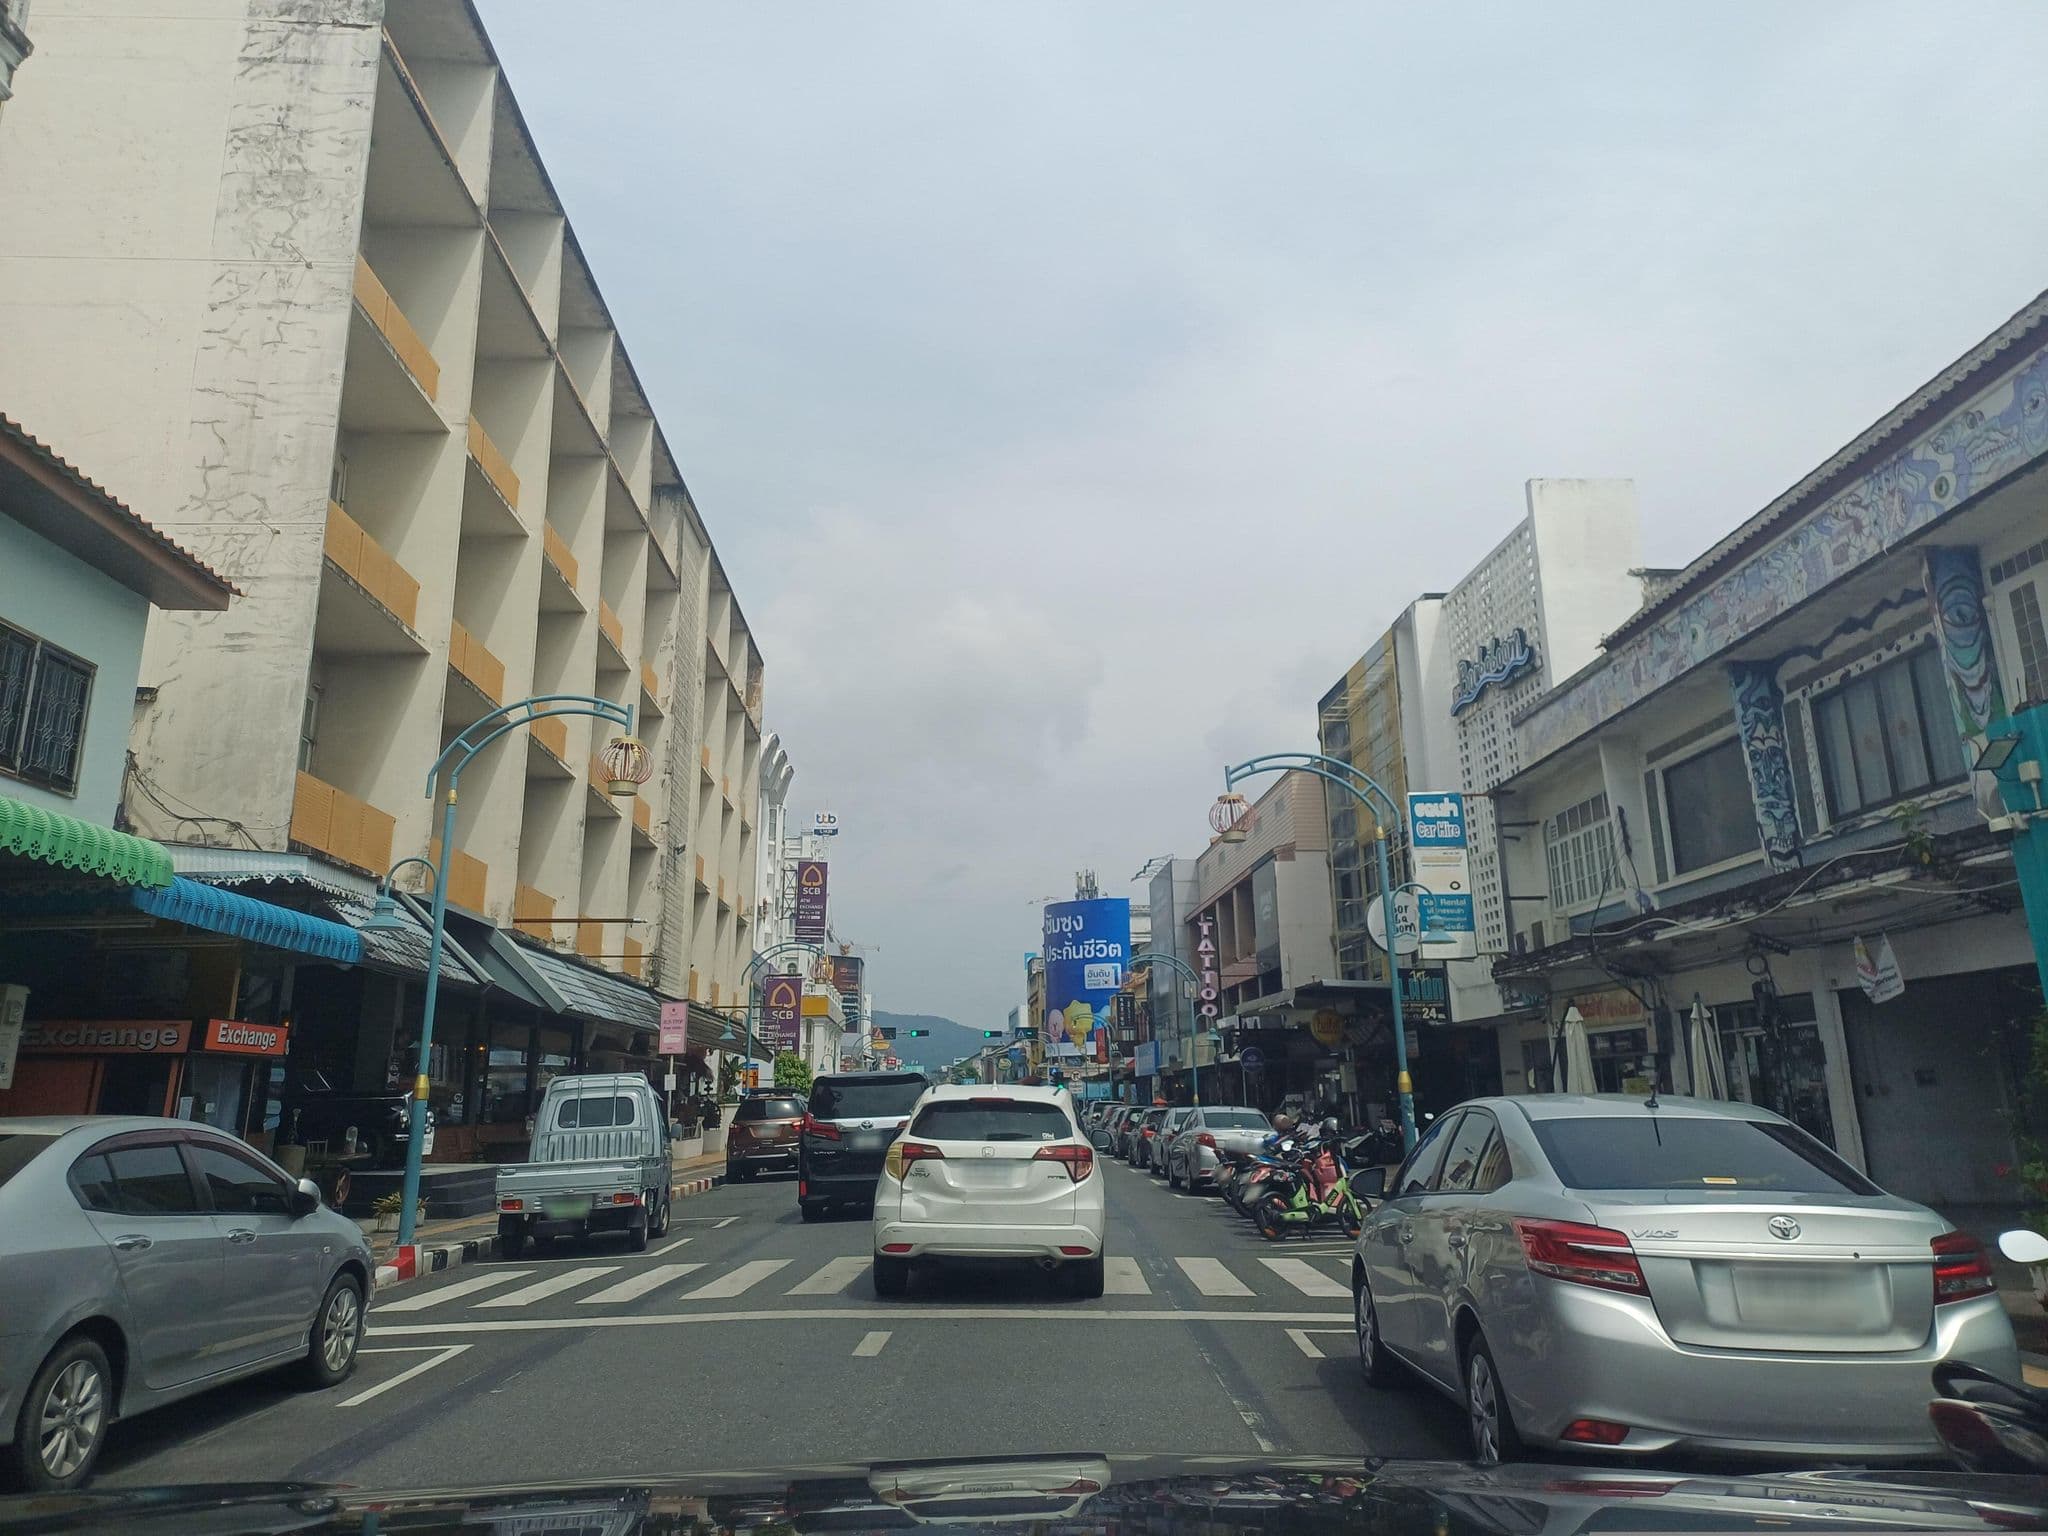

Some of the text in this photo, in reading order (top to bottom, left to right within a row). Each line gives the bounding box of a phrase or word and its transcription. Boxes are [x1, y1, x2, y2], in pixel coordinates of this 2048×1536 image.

[815, 813, 837, 824] ttb
[1416, 820, 1461, 839] Car Hire
[802, 887, 821, 895] SCB
[1440, 898, 1467, 906] Rental
[1045, 914, 1084, 938] ซัมซุง
[1046, 938, 1122, 962] ประกันชีวิต
[1197, 921, 1218, 1017] TATTOO
[772, 1010, 794, 1020] SCB
[1422, 1007, 1437, 1019] 24
[23, 1023, 180, 1050] Exchange
[217, 1023, 277, 1051] Exchange
[1631, 1229, 1679, 1239] VIOS
